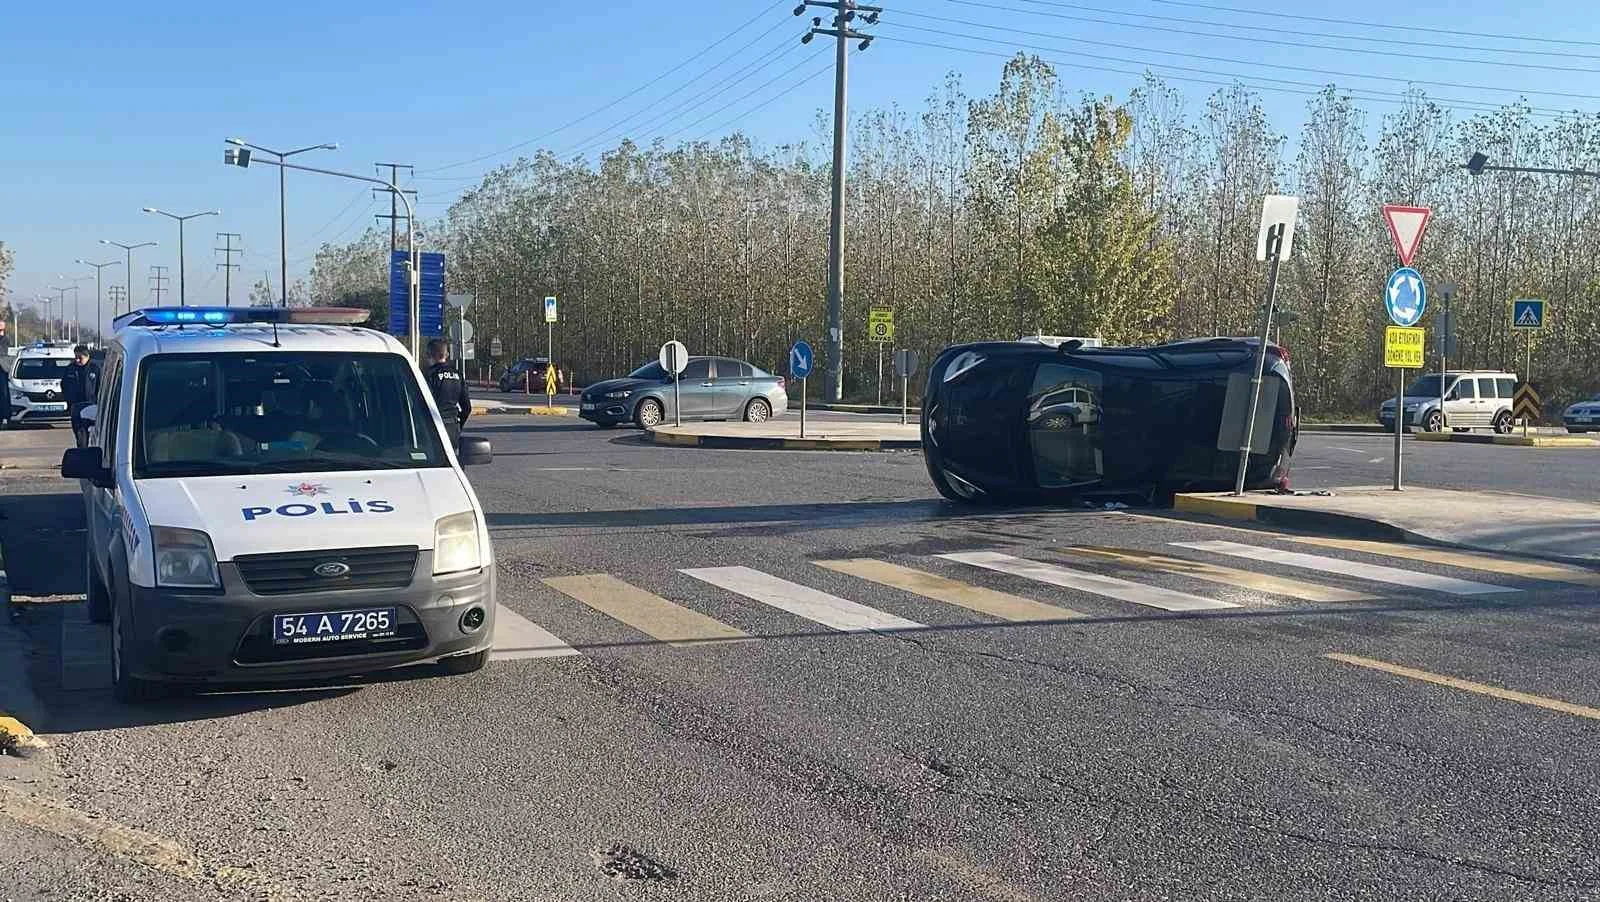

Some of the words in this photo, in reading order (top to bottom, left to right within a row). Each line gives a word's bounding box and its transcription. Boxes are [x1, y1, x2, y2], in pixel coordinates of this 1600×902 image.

[241, 498, 394, 520] POLİS
[282, 617, 307, 636] 54
[317, 615, 333, 634] A
[341, 611, 389, 633] 7265
